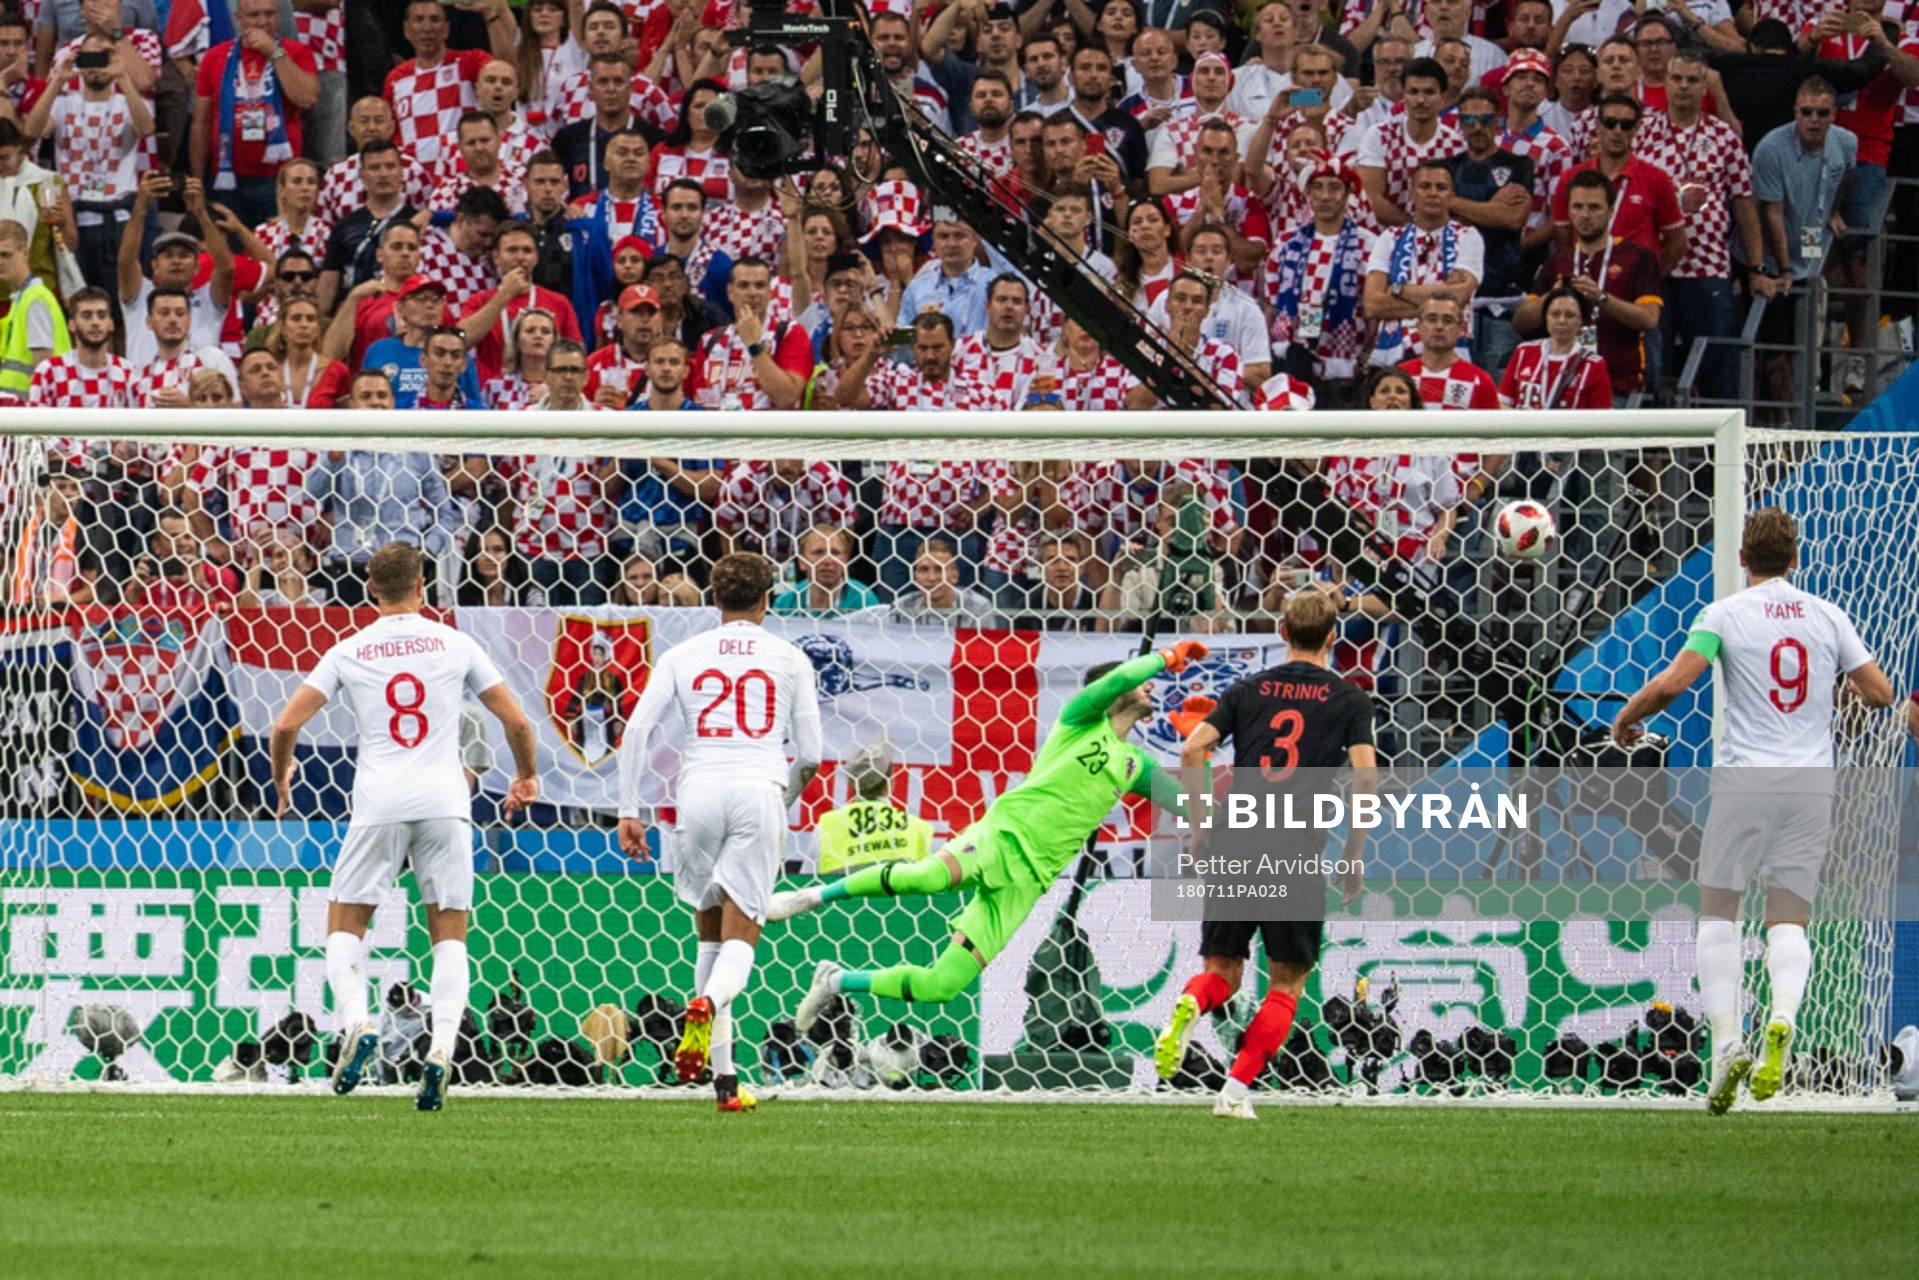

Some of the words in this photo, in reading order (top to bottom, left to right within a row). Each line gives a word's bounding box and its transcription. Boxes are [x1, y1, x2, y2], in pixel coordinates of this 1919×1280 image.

[1764, 601, 1805, 619] KANE
[356, 637, 446, 661] HENDERSON
[719, 638, 757, 655] DELE
[1769, 637, 1808, 714] 9
[692, 668, 776, 739] 20
[1259, 681, 1331, 703] STRINIĆ
[385, 672, 429, 748] 8
[1076, 741, 1110, 776] 23
[1259, 709, 1305, 783] 3
[848, 806, 908, 838] 3833
[848, 838, 908, 857] STEWARD
